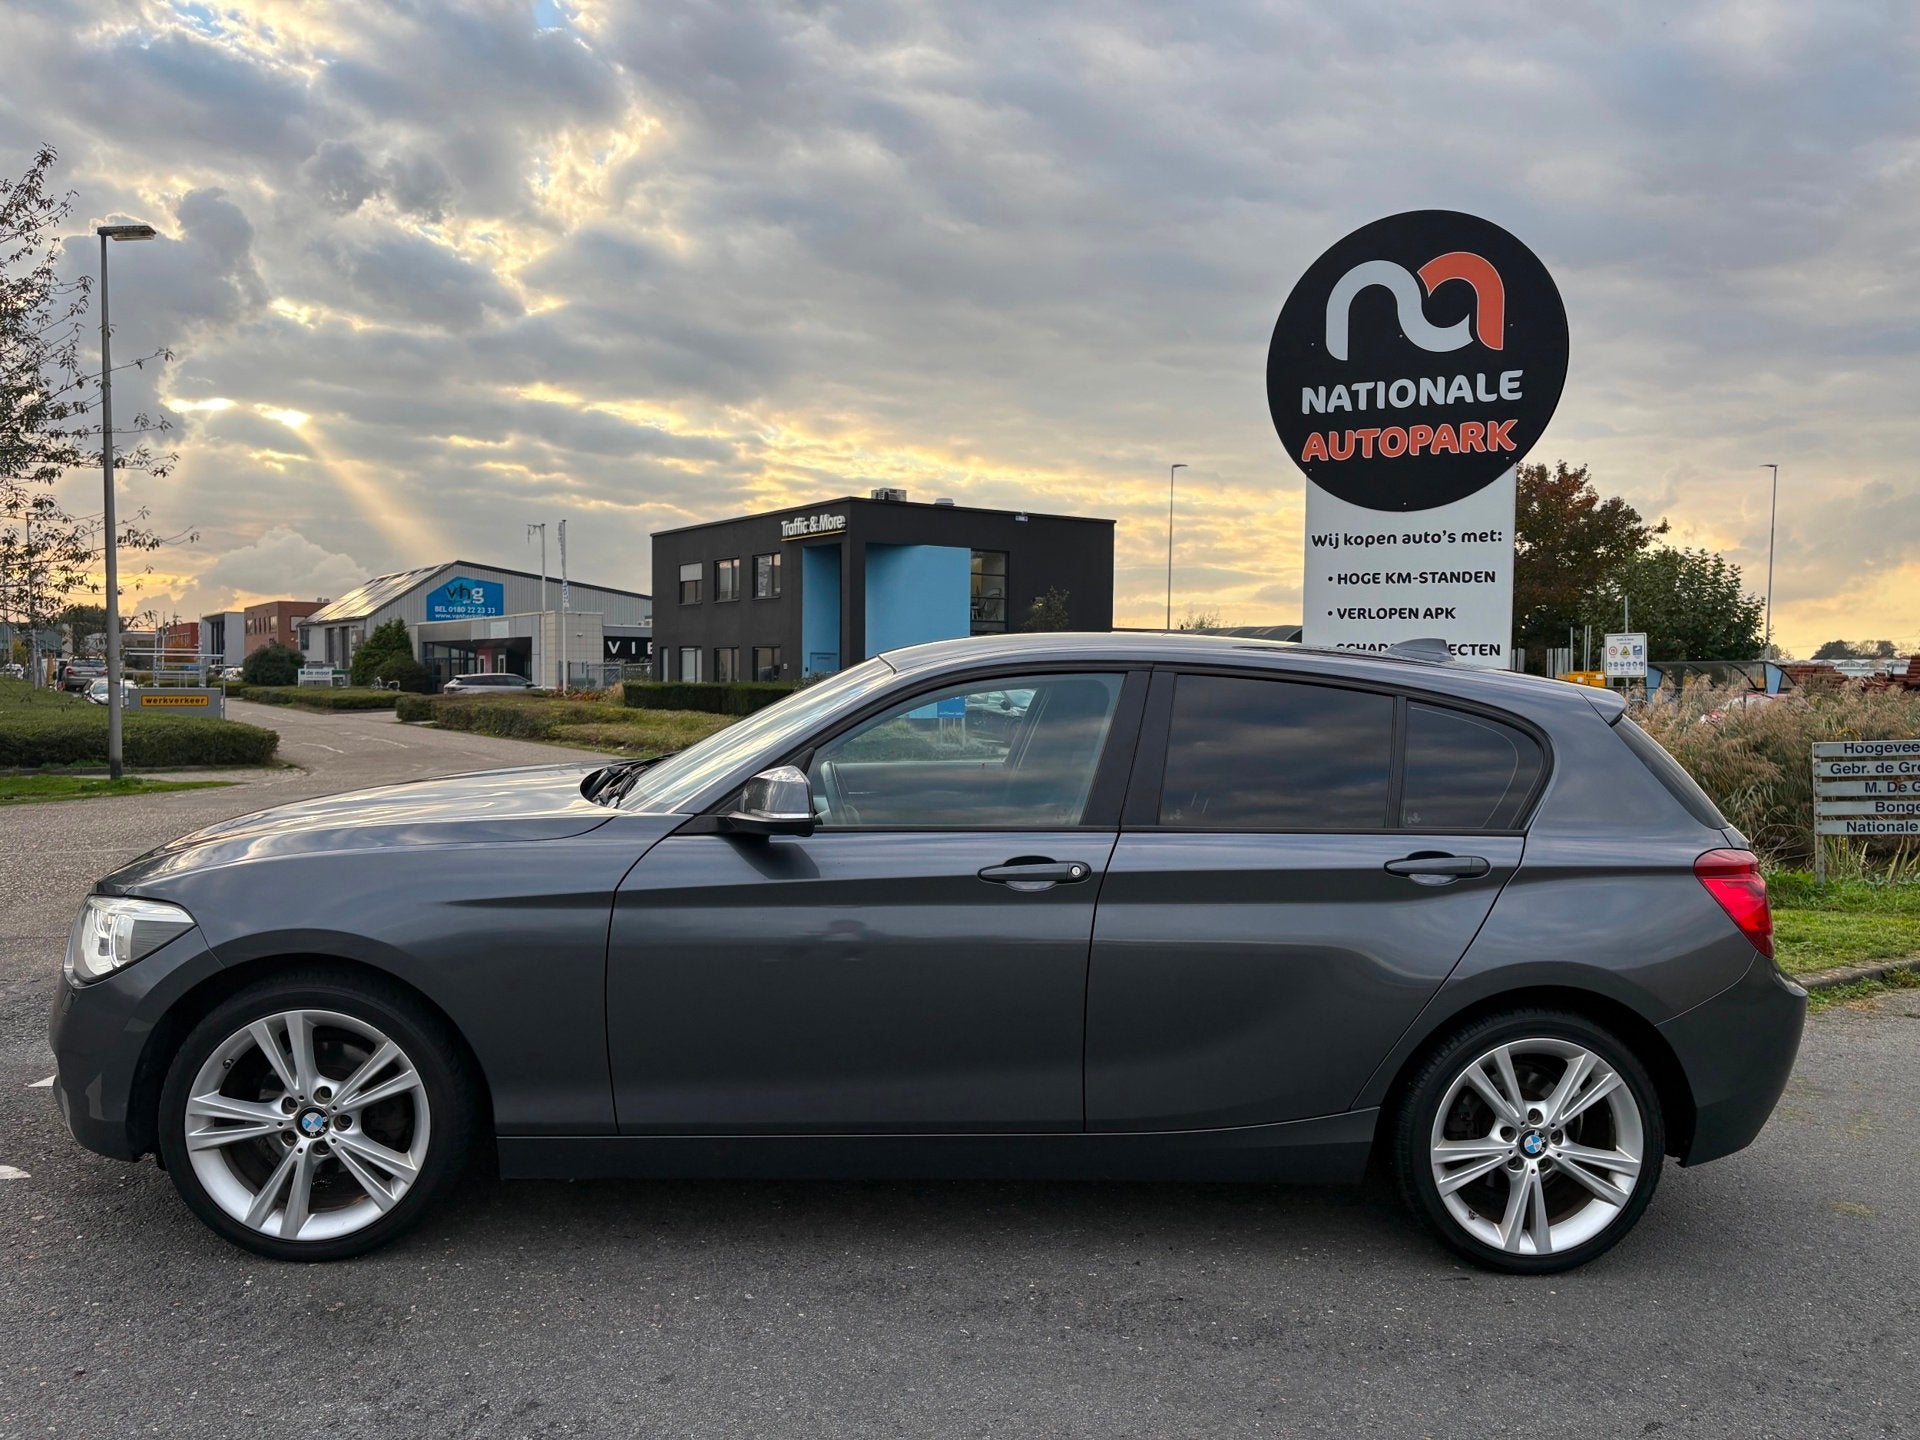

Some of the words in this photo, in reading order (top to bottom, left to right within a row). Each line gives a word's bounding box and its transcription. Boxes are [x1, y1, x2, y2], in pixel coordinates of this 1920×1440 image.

[1302, 369, 1523, 414] NATIONALE
[1302, 419, 1518, 462] AUTOPARK
[781, 517, 809, 536] Traffic
[809, 516, 818, 532] &
[819, 514, 846, 531] More
[1311, 533, 1339, 549] Wij
[1343, 532, 1397, 548] kopen
[1402, 529, 1456, 544] auto's
[1461, 529, 1503, 542] met:
[1337, 572, 1381, 584] HOGE
[1385, 571, 1496, 584] KM-STANDEN
[446, 583, 485, 604] vhg
[1336, 607, 1419, 620] VERLOPEN
[1423, 607, 1456, 619] APK
[1830, 762, 1870, 774] Gebr.
[1875, 762, 1894, 773] de
[1864, 782, 1881, 793] M.
[1887, 781, 1907, 792] De
[1846, 821, 1919, 833] Nationale
